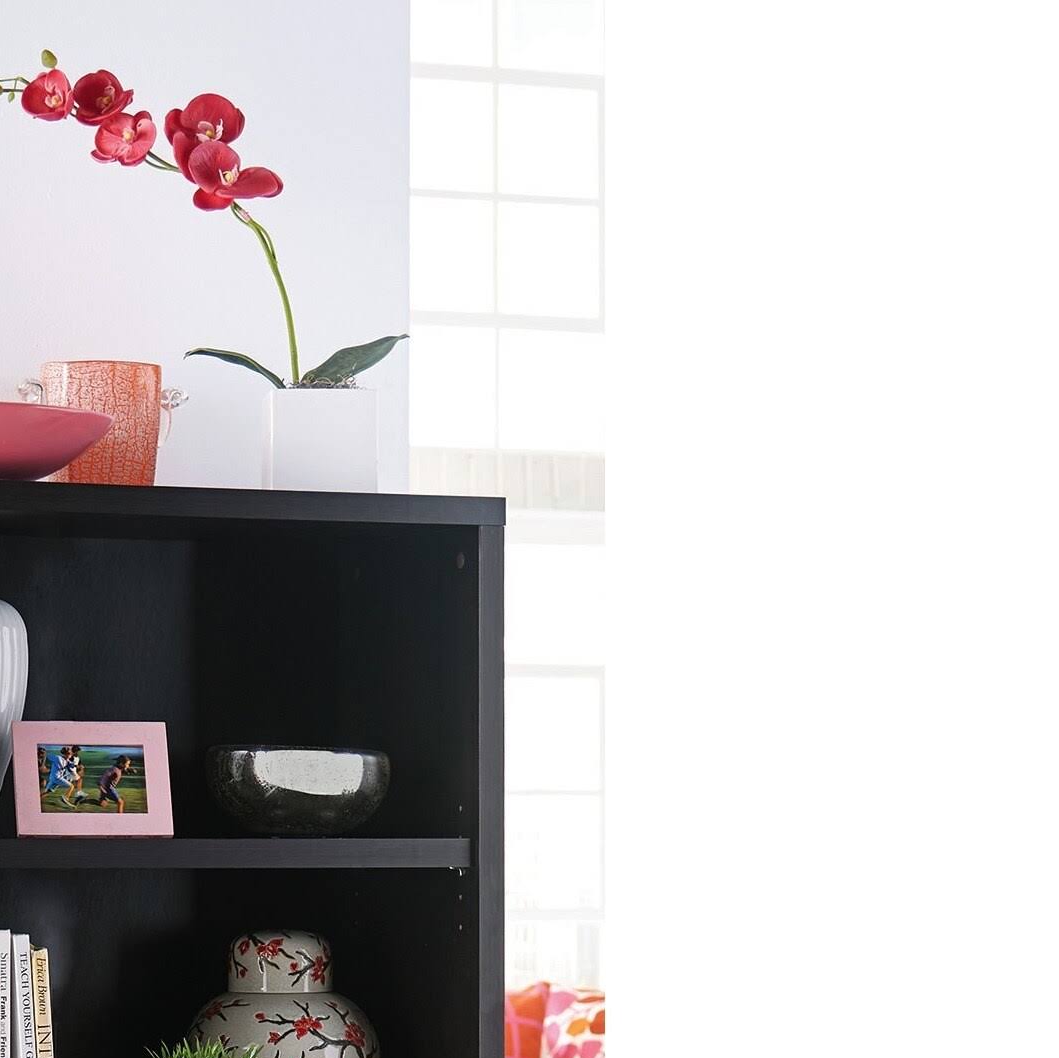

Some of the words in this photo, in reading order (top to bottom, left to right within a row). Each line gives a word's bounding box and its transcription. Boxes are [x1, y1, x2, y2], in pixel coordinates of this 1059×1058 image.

[19, 952, 31, 989] TEACH
[36, 957, 47, 984] Erica
[0, 996, 8, 1020] Frank
[37, 985, 48, 1017] Brown
[0, 1021, 8, 1035] and
[21, 990, 34, 1048] YOURSELF
